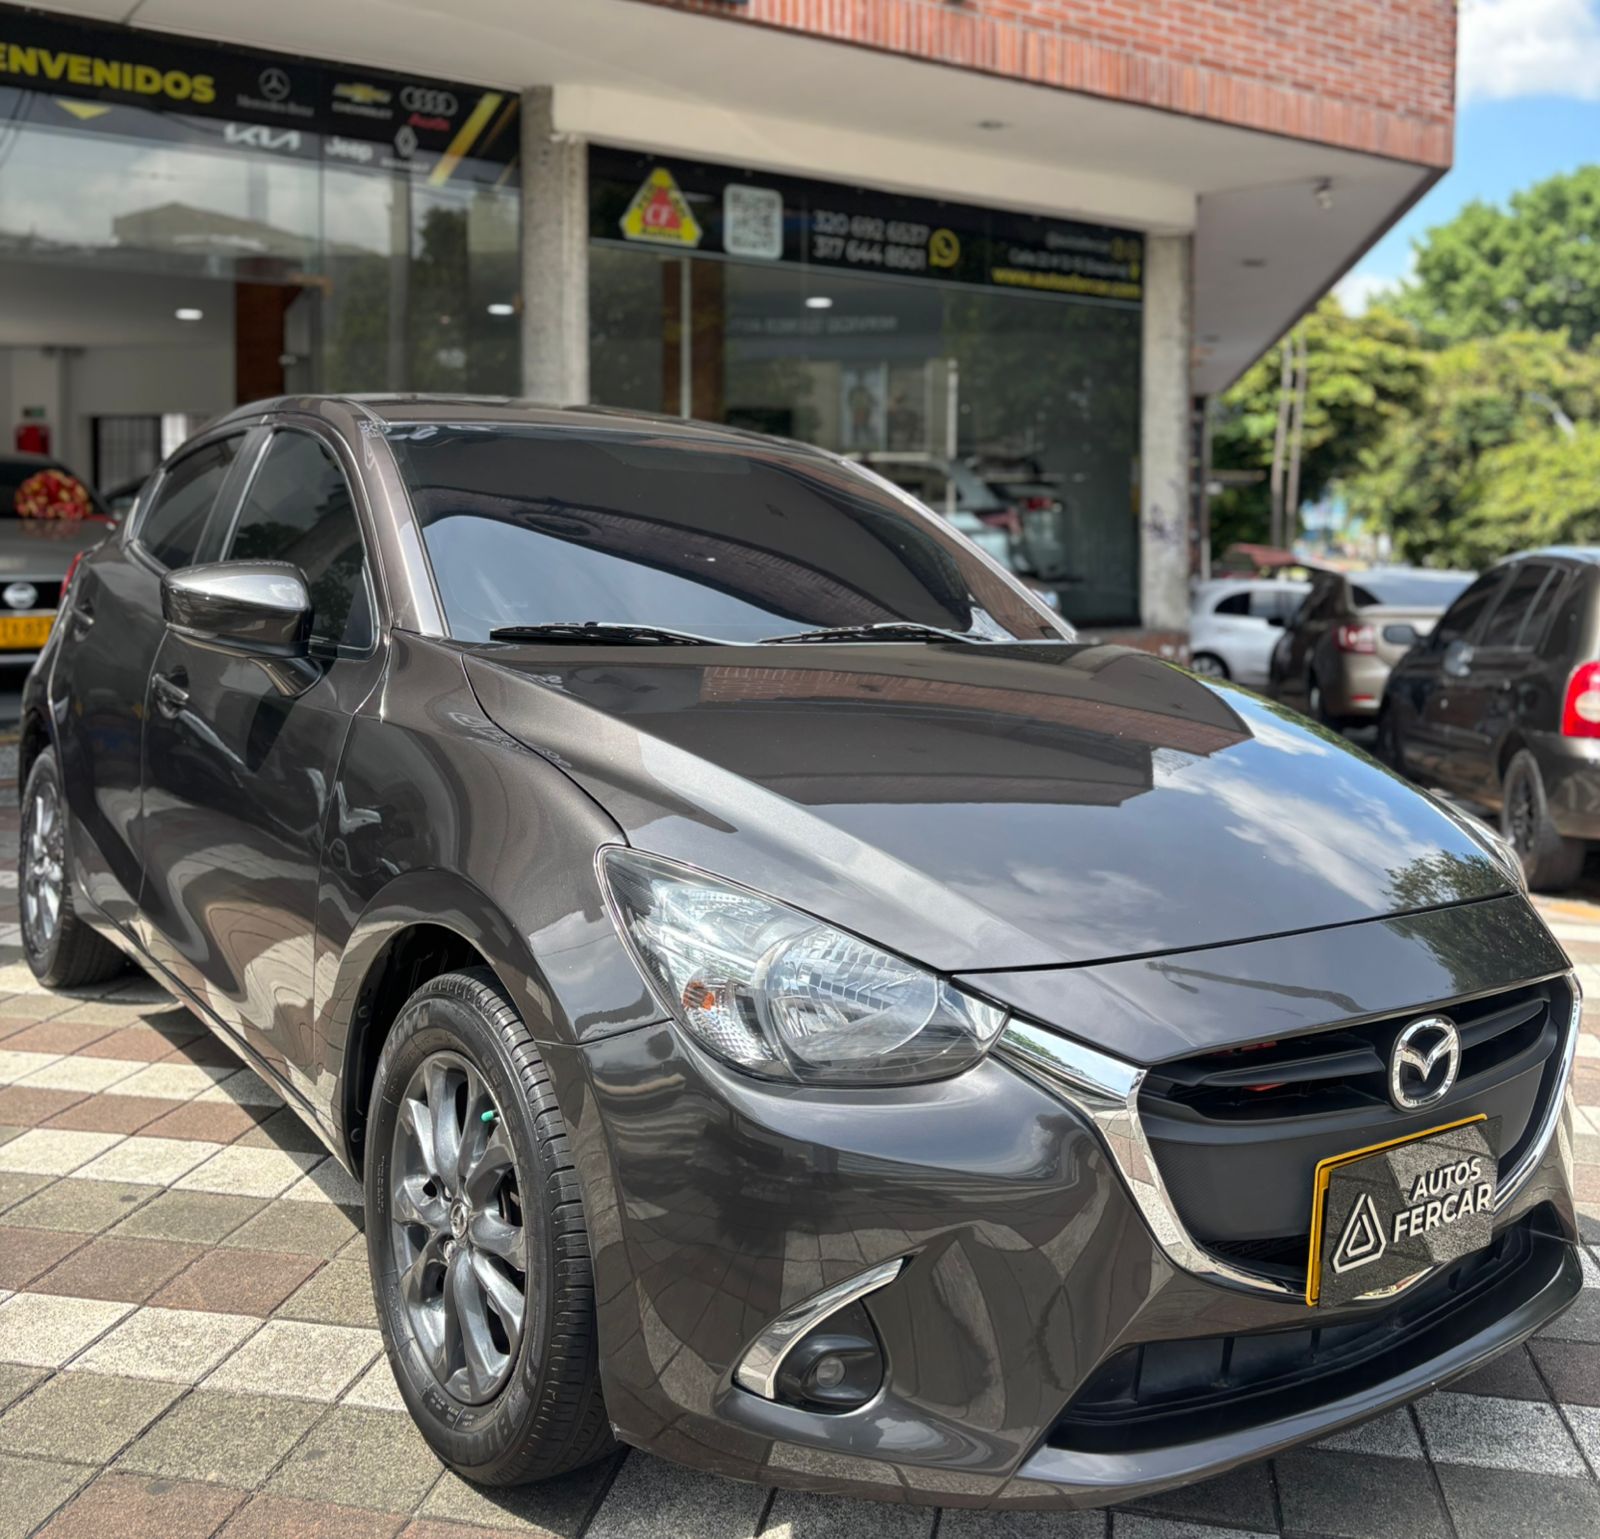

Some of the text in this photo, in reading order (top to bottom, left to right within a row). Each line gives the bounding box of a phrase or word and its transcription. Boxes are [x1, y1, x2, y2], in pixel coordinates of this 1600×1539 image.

[224, 123, 300, 151] KIA
[325, 136, 373, 163] Jeep
[1410, 1156, 1482, 1202] AUTOS
[1392, 1183, 1493, 1243] FERCAR
